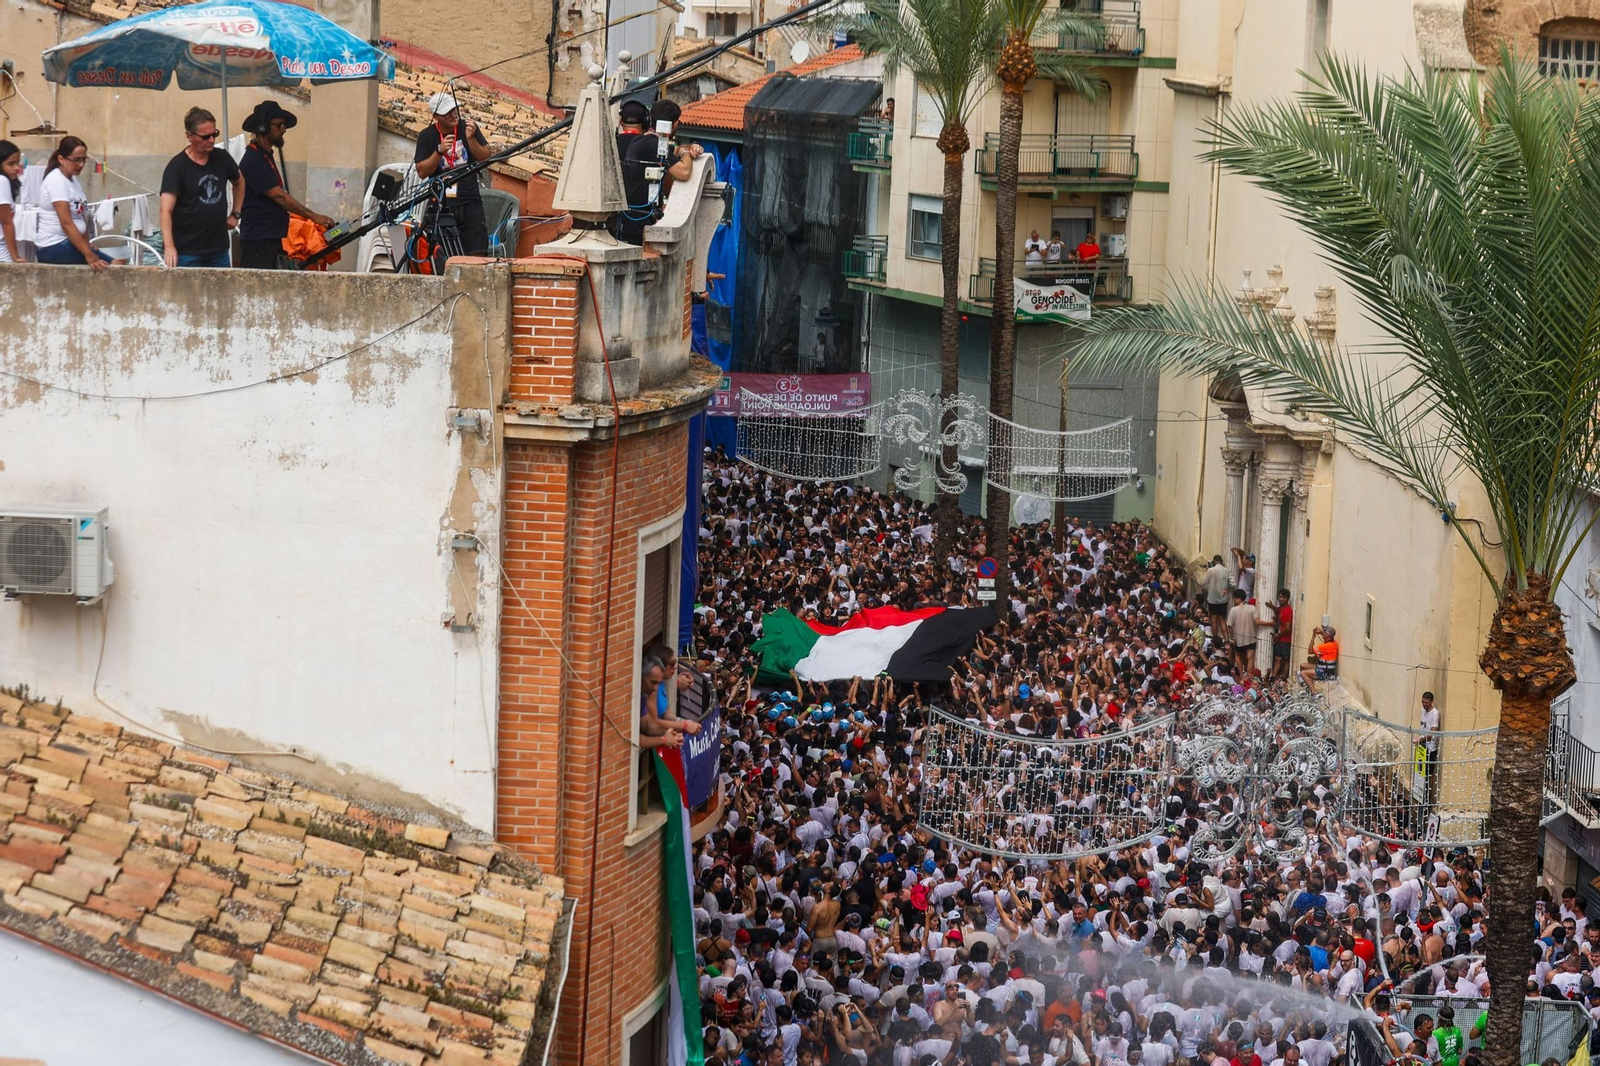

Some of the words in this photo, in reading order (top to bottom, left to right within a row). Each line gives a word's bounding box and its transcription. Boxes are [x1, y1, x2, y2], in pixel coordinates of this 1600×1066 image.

[281, 56, 306, 76] Pide
[308, 61, 328, 76] un
[328, 58, 371, 76] Deseo
[1031, 295, 1073, 304] GENOCIDE
